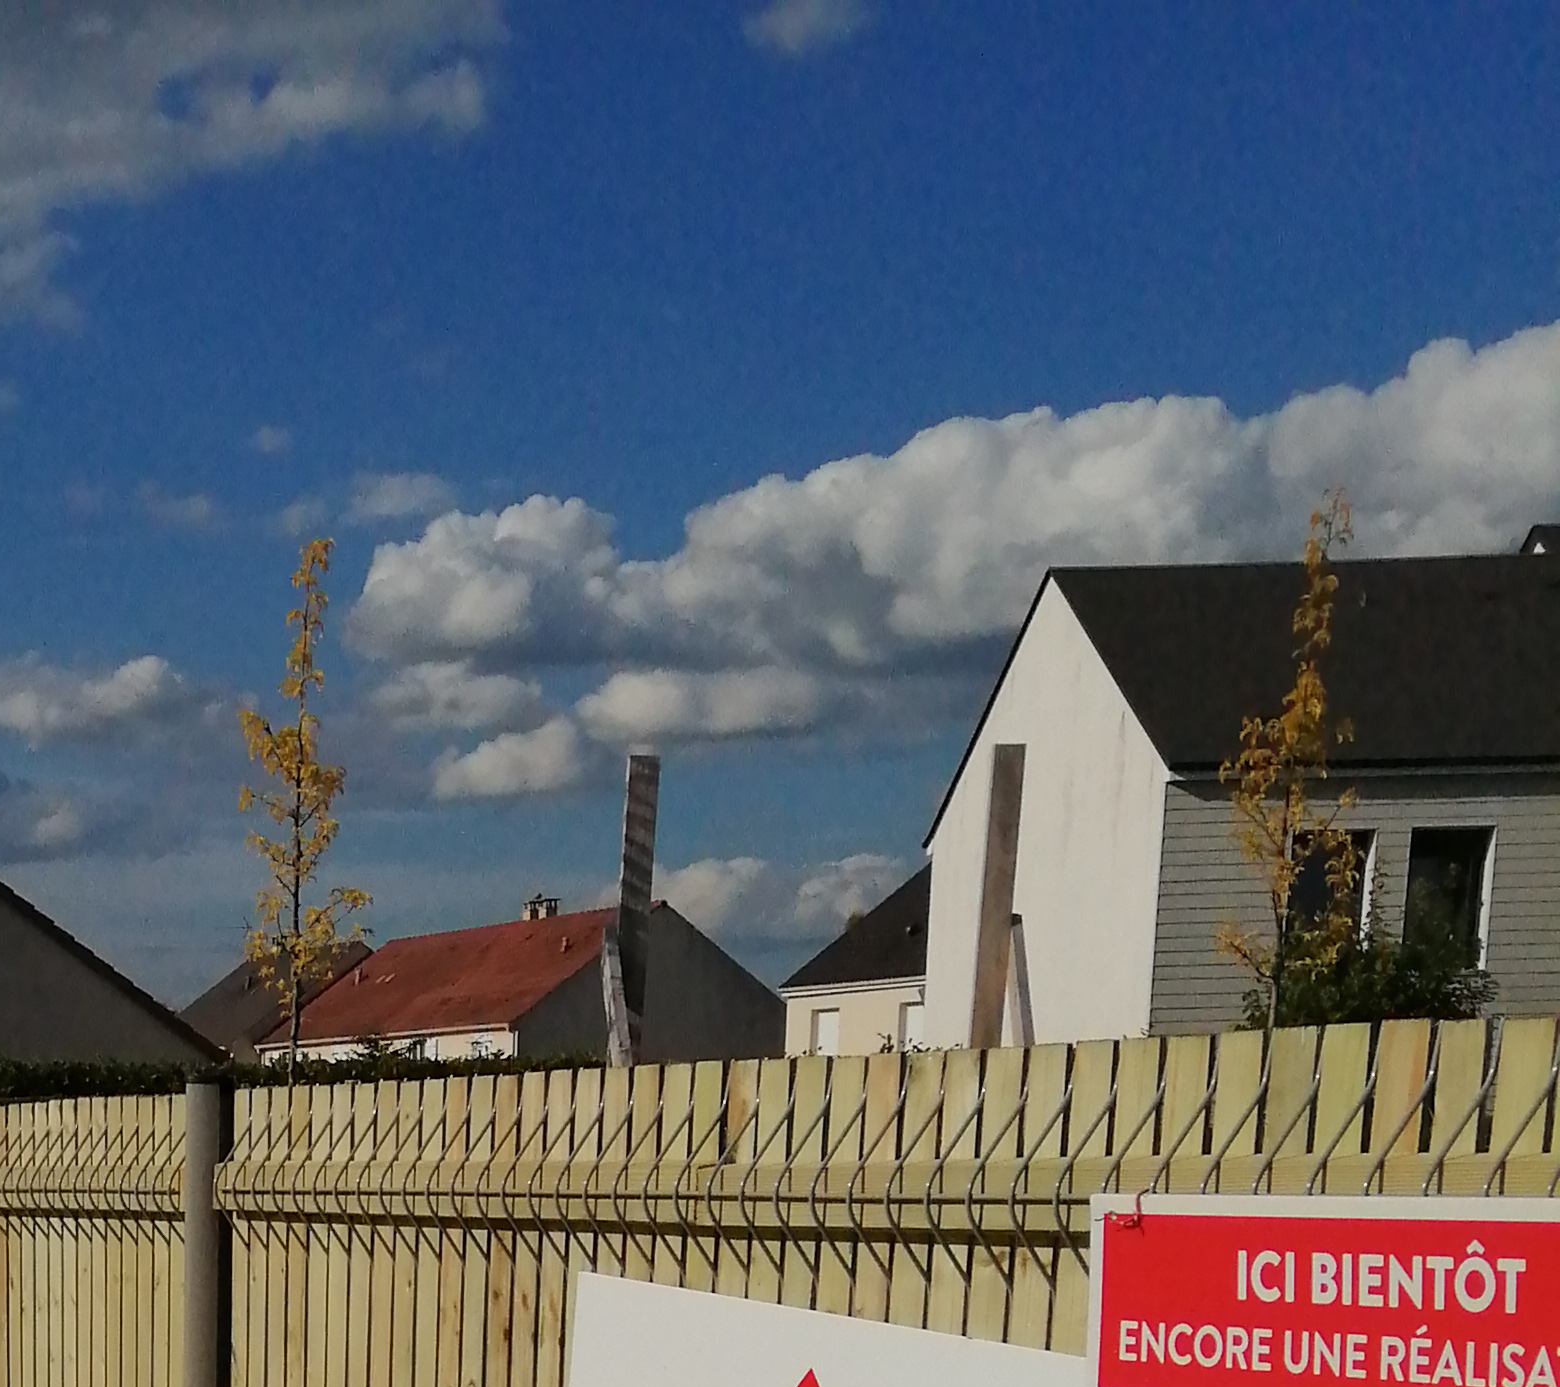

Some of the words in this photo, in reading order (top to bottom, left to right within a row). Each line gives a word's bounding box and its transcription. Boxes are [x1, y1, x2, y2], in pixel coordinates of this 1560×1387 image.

[1237, 1250, 1295, 1303] ICI
[1311, 1238, 1527, 1314] BIENTÔT
[1118, 1320, 1273, 1372] ENCORE
[1283, 1330, 1368, 1379] UNE
